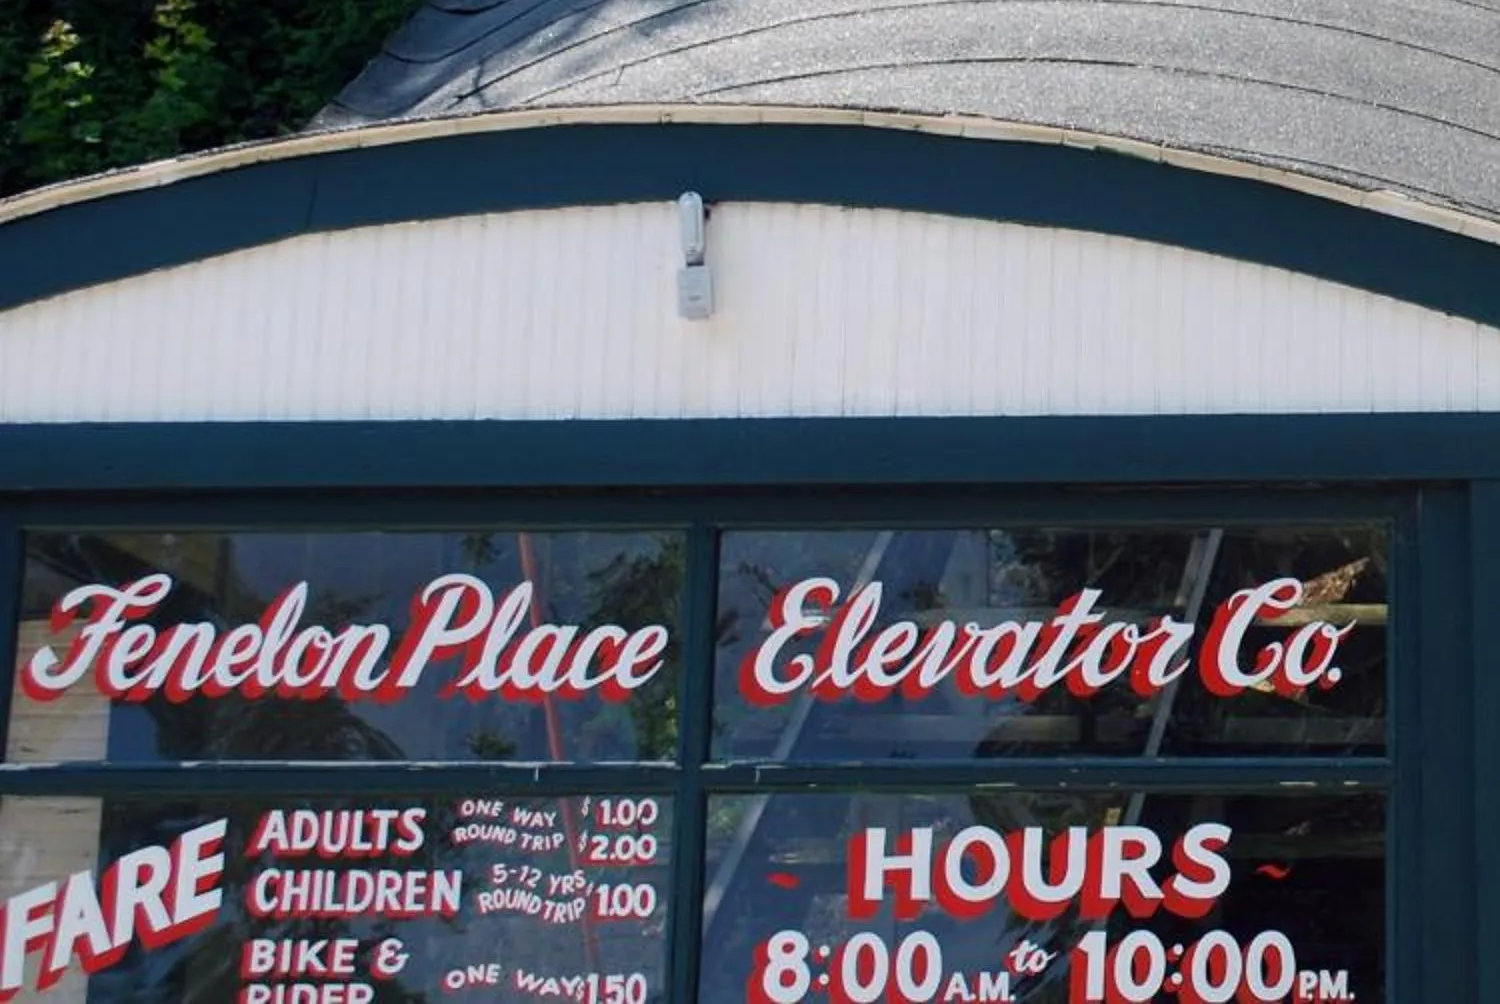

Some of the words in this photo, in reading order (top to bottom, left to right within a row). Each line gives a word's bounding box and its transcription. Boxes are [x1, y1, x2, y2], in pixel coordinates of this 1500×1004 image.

[31, 574, 389, 692] Fenelon
[399, 573, 669, 692] Place
[754, 577, 1195, 693] Elevator
[1214, 577, 1357, 691] Co.
[257, 808, 426, 853] ADULTS
[461, 800, 504, 817] ONE
[513, 807, 557, 827] WAY
[454, 824, 517, 845] ROUND
[522, 832, 565, 851] TRIP
[578, 830, 658, 860] $2.00
[493, 863, 542, 888] 5-12
[864, 823, 1233, 903] HOURS
[1, 818, 228, 990] FARE
[255, 869, 462, 913] CHILDREN
[478, 888, 542, 914] ROUND
[544, 898, 586, 924] TRIP
[249, 939, 359, 974] BIKE
[377, 939, 409, 974] &
[762, 930, 942, 1004] 8:00
[943, 971, 1017, 1003] A.M.
[1010, 936, 1057, 972] to
[1077, 930, 1297, 1004] 10:00
[447, 964, 501, 989] ONE
[517, 969, 580, 997] WAY
